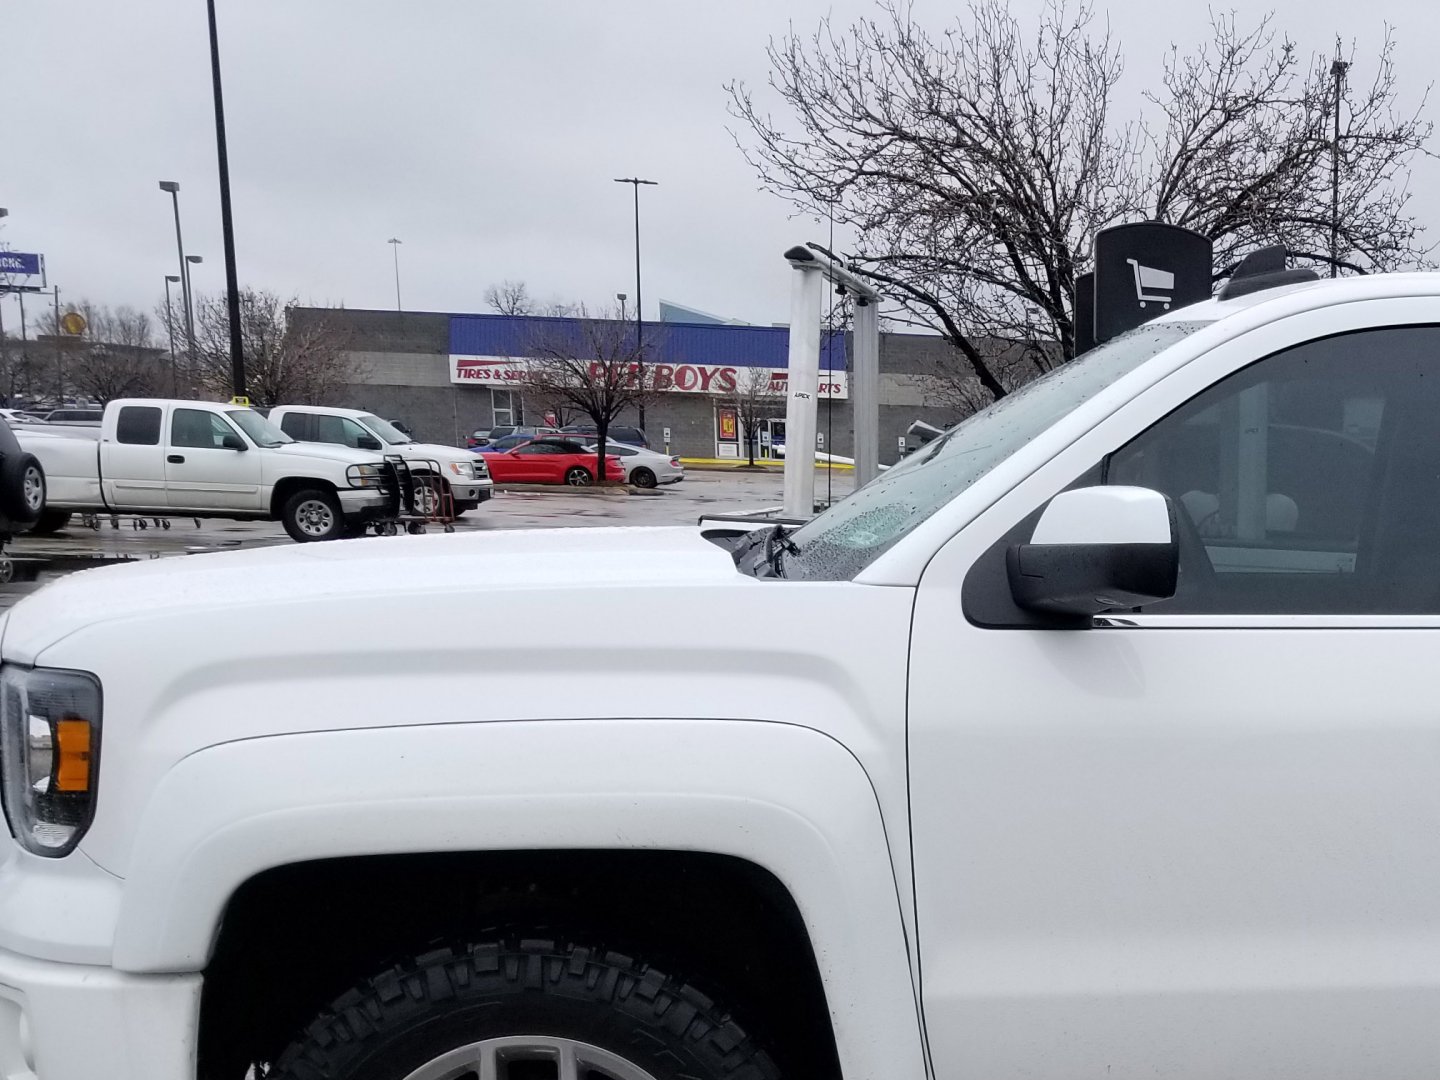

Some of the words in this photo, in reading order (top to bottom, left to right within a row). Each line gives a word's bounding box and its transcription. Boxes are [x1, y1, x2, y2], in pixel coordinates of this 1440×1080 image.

[456, 368, 490, 379] TIRES
[492, 370, 501, 380] &
[653, 365, 737, 392] BOYS
[767, 381, 789, 392] AUT
[817, 383, 842, 394] RTS
